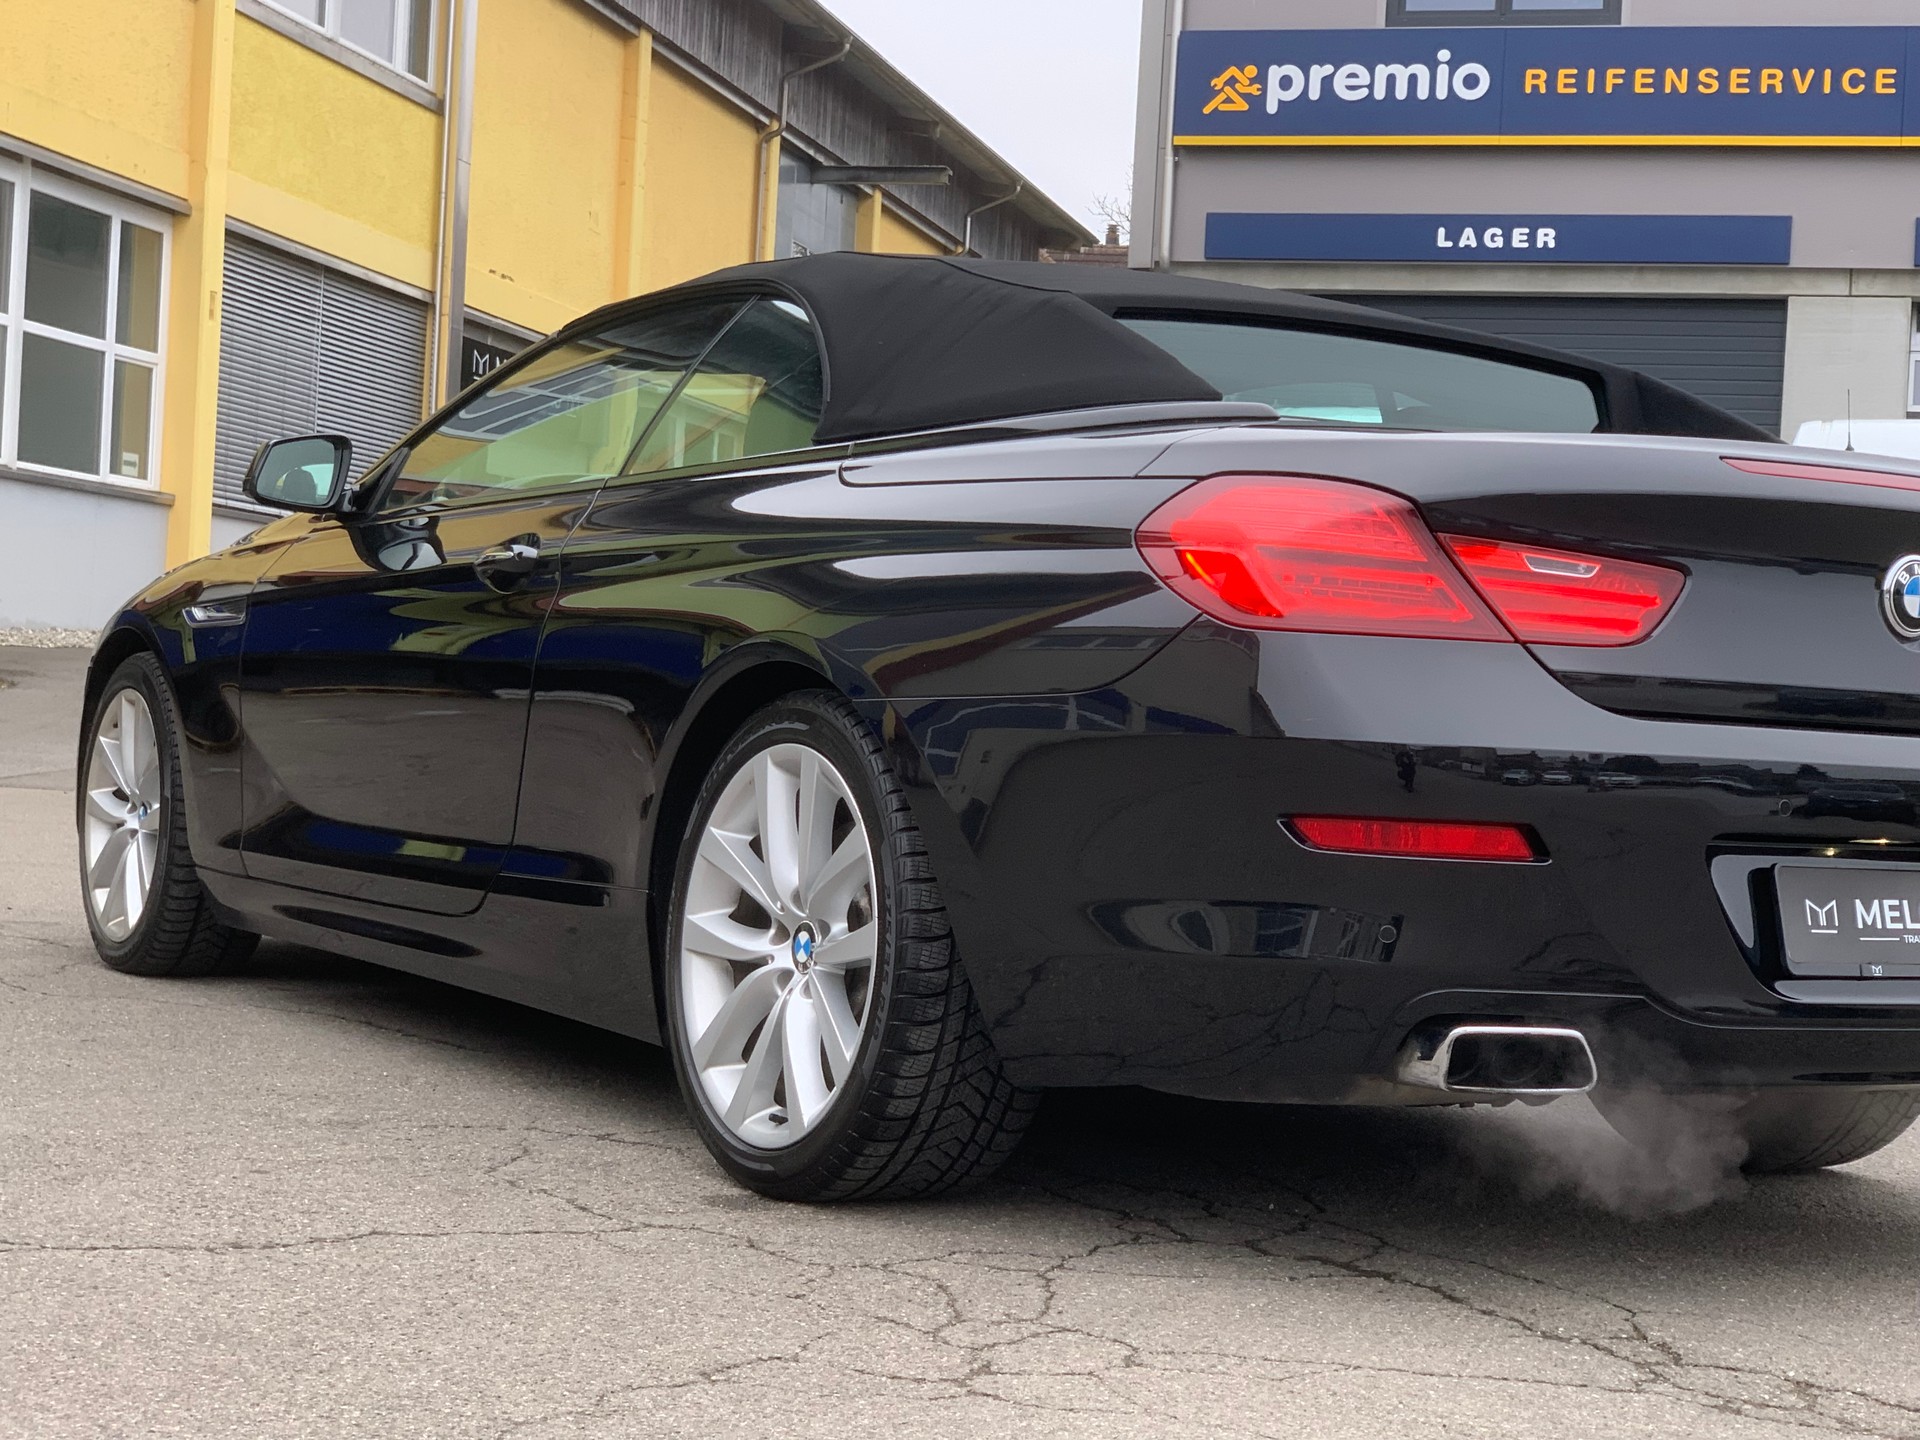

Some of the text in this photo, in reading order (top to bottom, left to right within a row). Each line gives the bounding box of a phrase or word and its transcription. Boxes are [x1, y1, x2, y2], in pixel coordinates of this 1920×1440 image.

[1266, 49, 1897, 115] premio REIFENSERVICE
[1437, 227, 1556, 248] LAGER
[1855, 898, 1920, 929] MEL
[1903, 935, 1920, 944] TRA
